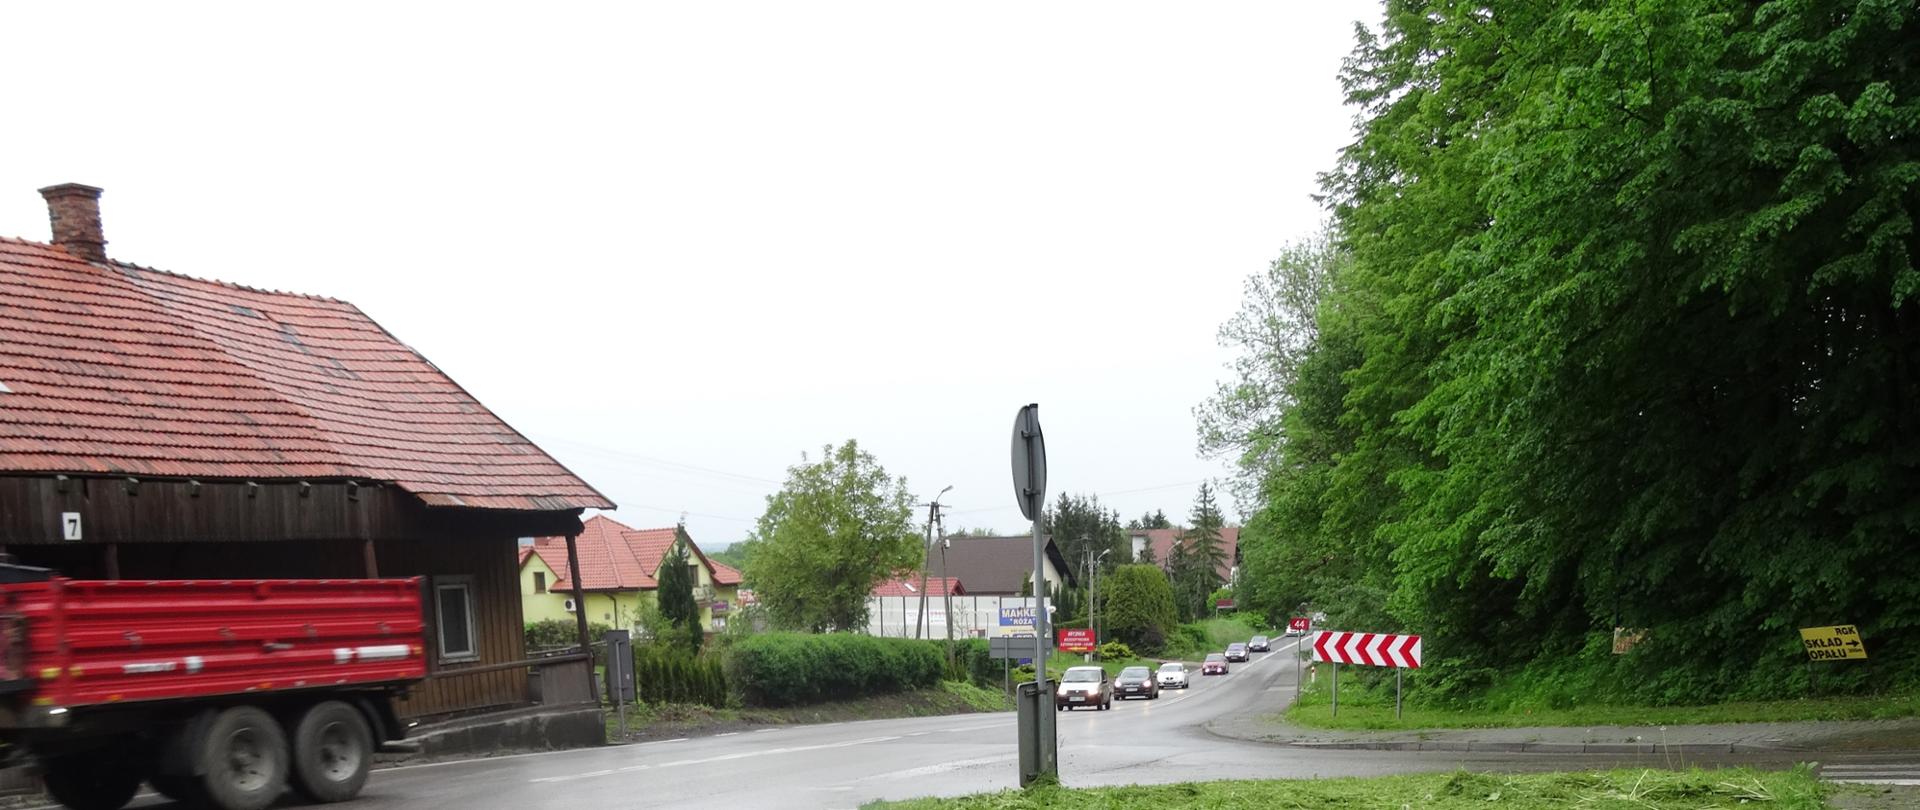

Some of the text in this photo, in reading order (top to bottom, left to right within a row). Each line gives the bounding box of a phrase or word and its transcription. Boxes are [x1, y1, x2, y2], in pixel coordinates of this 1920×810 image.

[68, 519, 77, 537] 7
[1002, 608, 1036, 618] MARKE
[1294, 620, 1305, 628] 44
[1835, 627, 1856, 635] RGK
[1805, 637, 1842, 648] SKŁAD
[1810, 649, 1847, 660] OPAŁU
